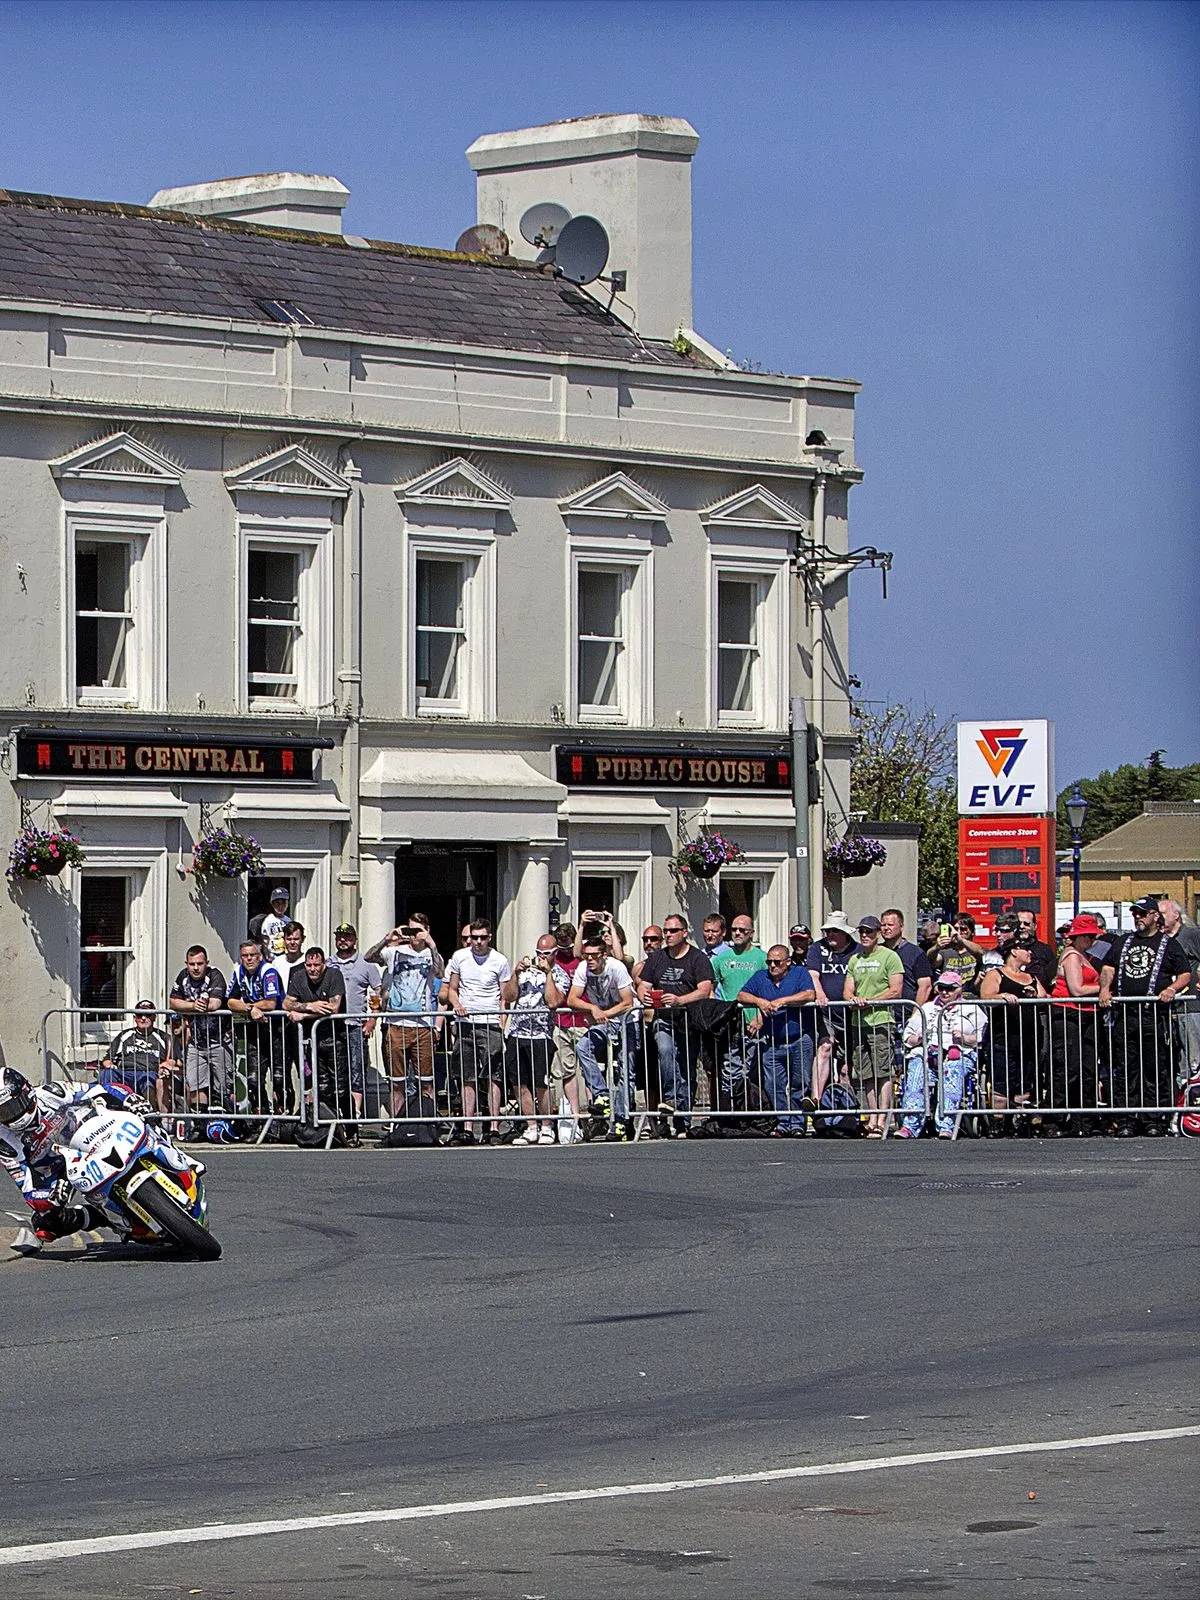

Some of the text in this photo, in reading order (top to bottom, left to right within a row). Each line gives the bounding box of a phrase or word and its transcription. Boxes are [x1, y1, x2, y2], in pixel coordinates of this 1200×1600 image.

[68, 744, 265, 773] THE CENTRAL
[596, 757, 766, 784] PUBLIC HOUSE
[969, 784, 1036, 807] EVF
[968, 829, 1017, 837] Convenience
[115, 1121, 142, 1146] 10
[85, 1160, 105, 1184] 10
